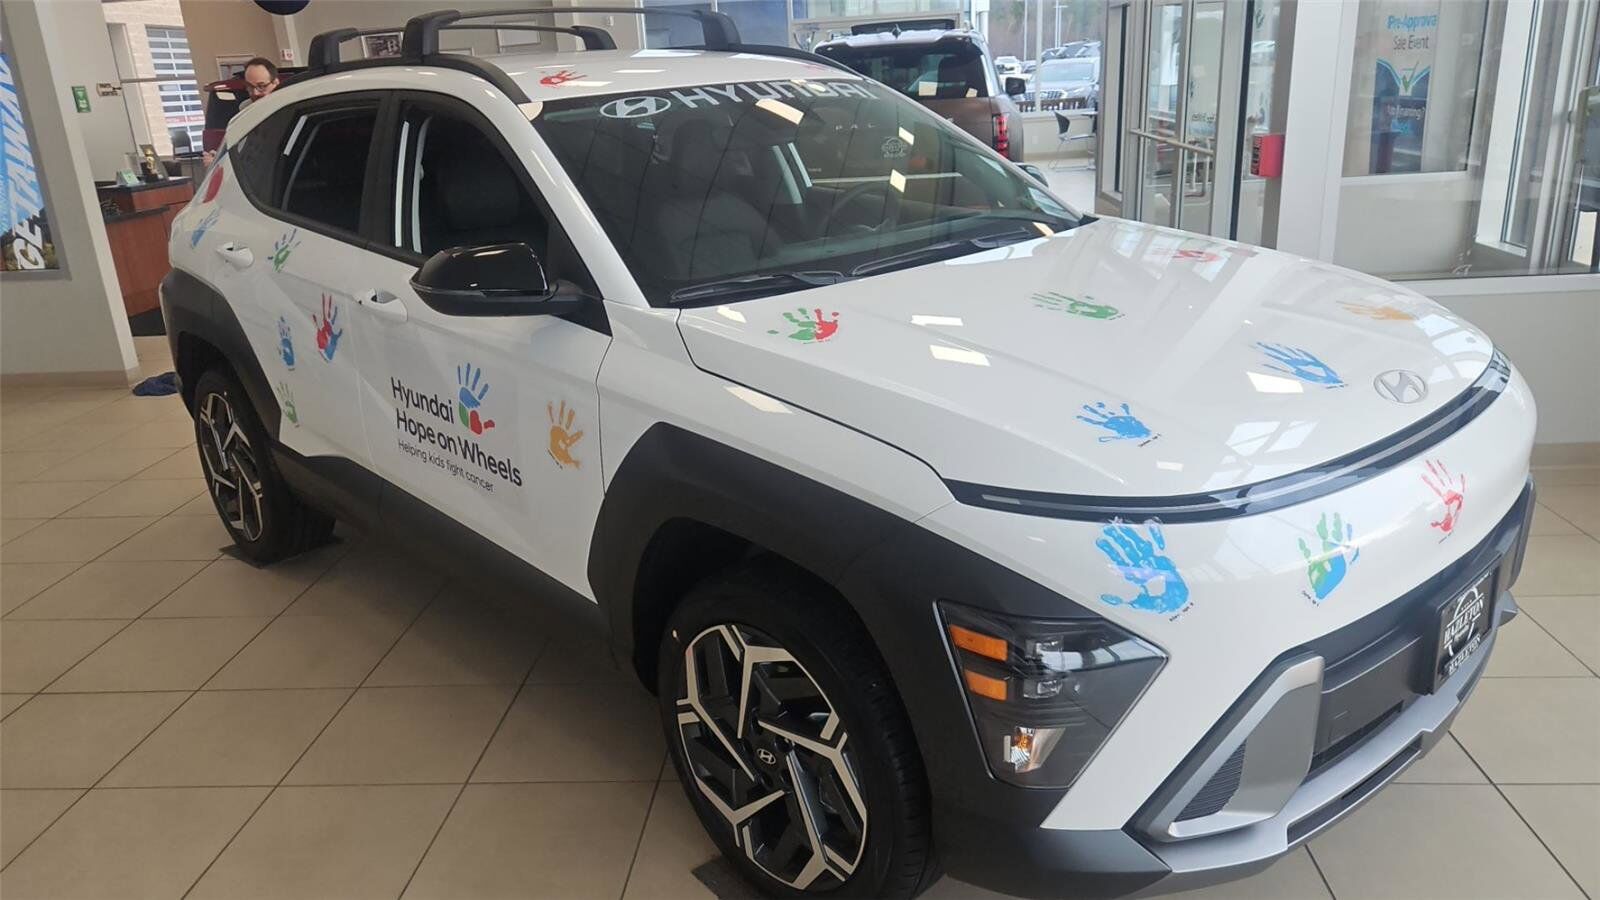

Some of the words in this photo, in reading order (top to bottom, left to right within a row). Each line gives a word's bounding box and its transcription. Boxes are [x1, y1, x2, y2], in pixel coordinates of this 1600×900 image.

[1408, 34, 1430, 50] Event
[670, 82, 879, 109] HYUNDAI
[391, 377, 454, 424] Hyundai
[396, 408, 436, 443] Hope
[437, 431, 458, 455] on
[457, 436, 522, 487] Wheels
[398, 440, 427, 463] Helping
[429, 452, 445, 469] kids
[446, 460, 464, 477] fight
[465, 471, 494, 493] cancer
